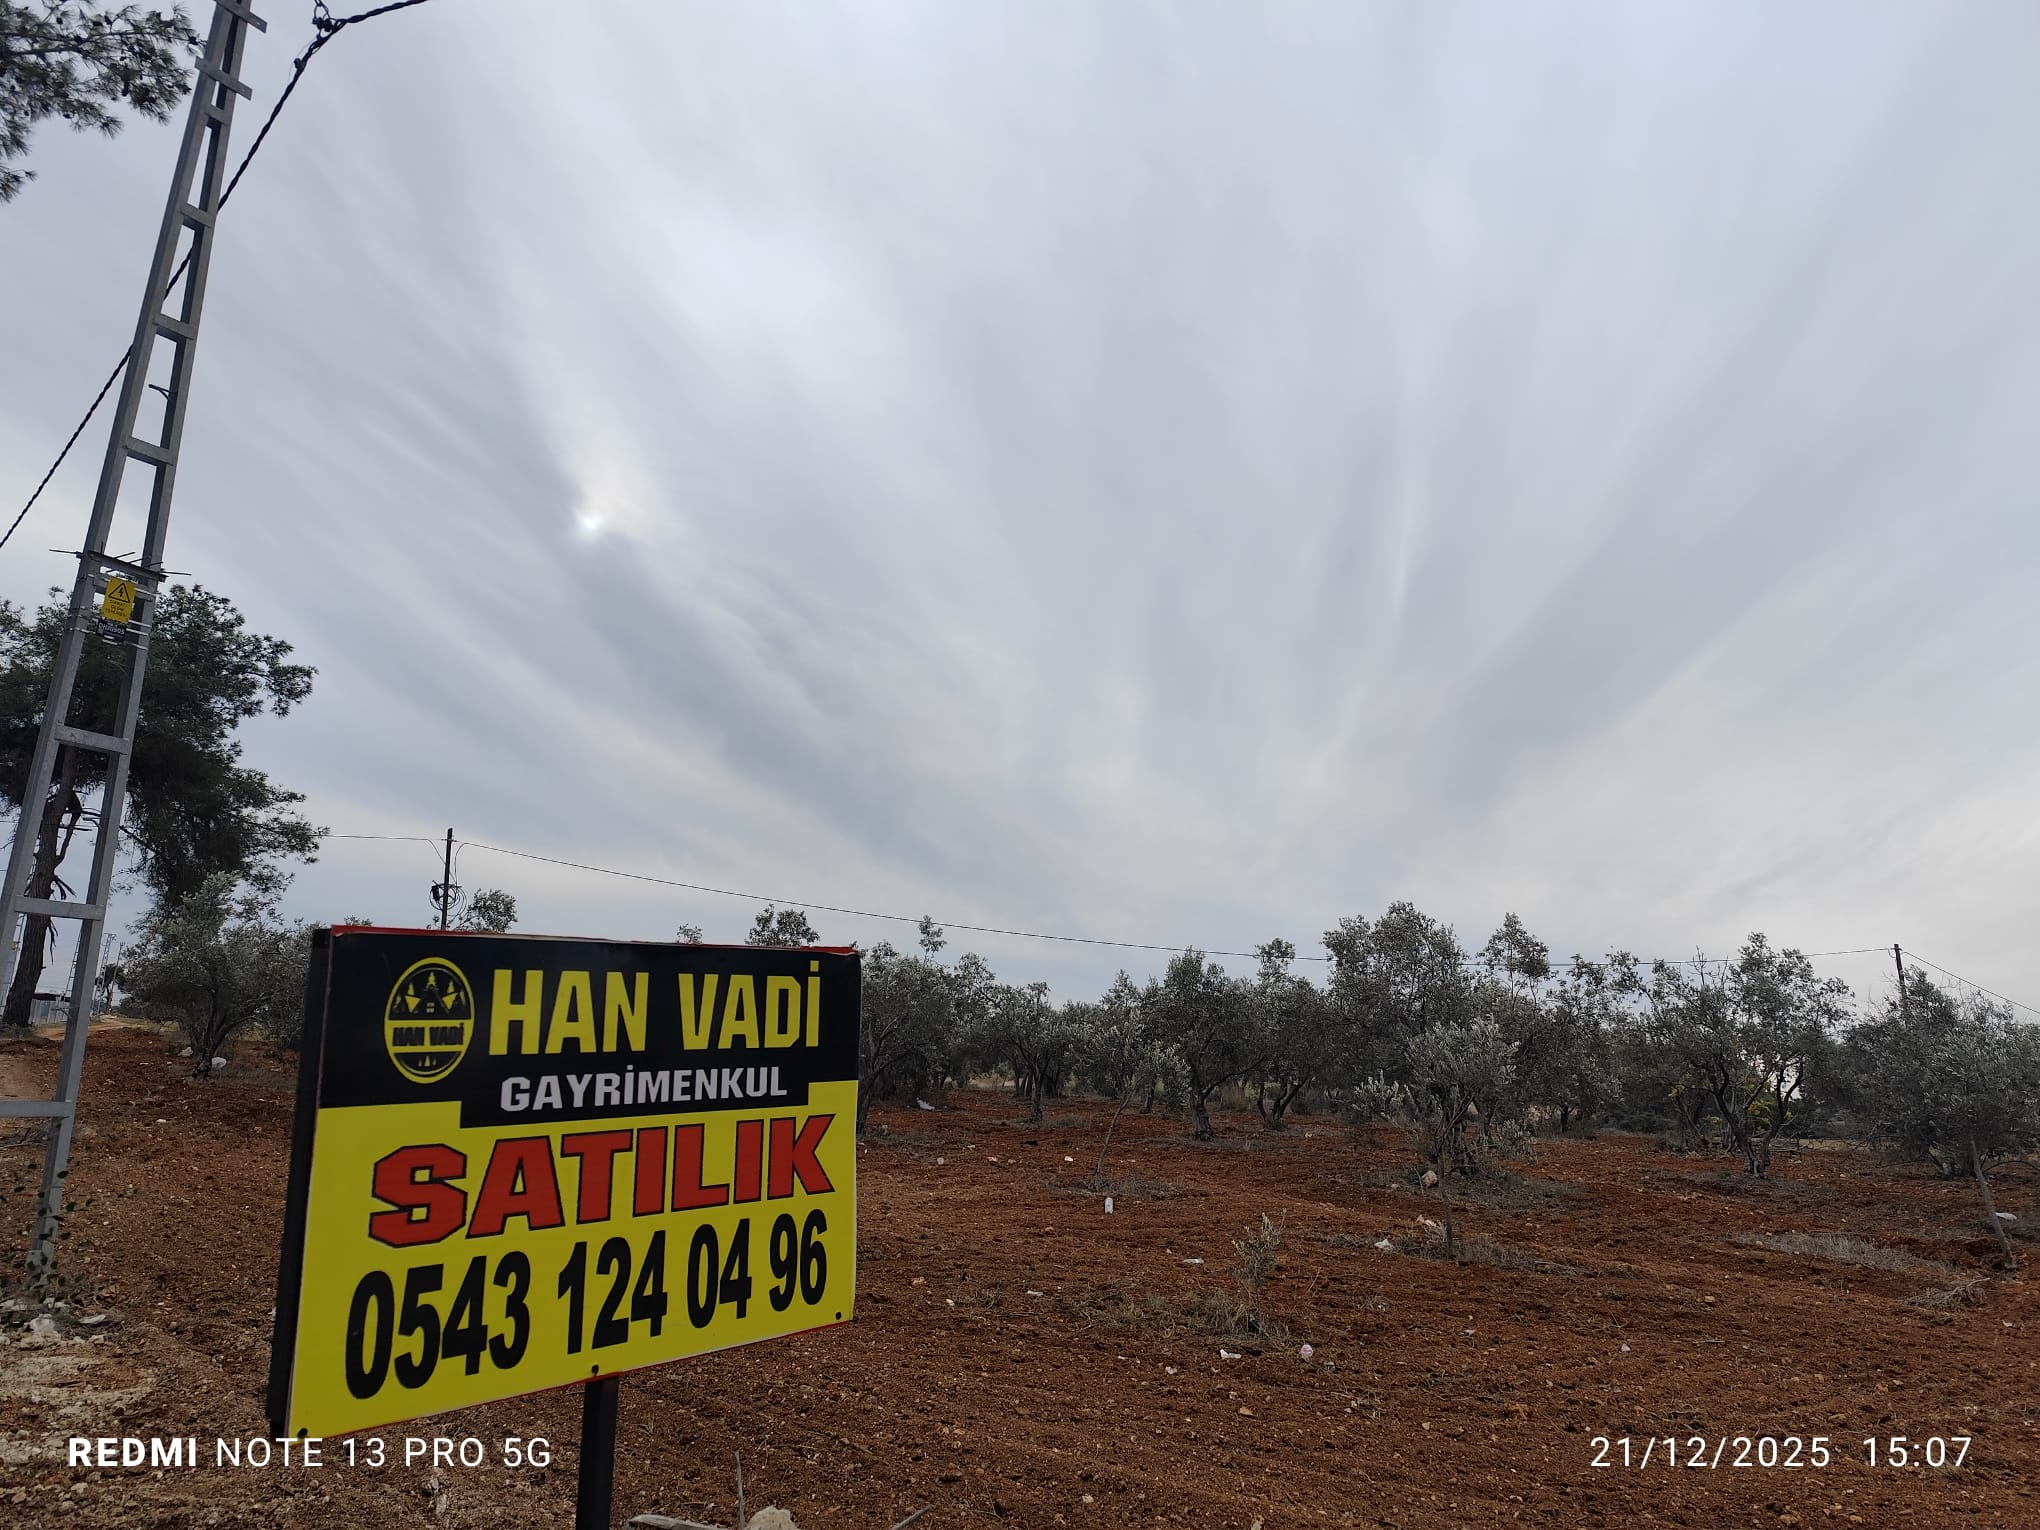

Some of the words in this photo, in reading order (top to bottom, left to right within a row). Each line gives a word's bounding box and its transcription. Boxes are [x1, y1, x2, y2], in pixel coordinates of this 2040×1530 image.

[488, 968, 650, 1056] HAN
[678, 961, 821, 1051] VADİ
[500, 1064, 788, 1112] GAYRİMENKUL
[368, 1113, 836, 1248] SATILIK
[345, 1251, 531, 1400] 0543
[557, 1229, 668, 1355] 124
[686, 1217, 753, 1329] 04
[768, 1208, 828, 1312] 96
